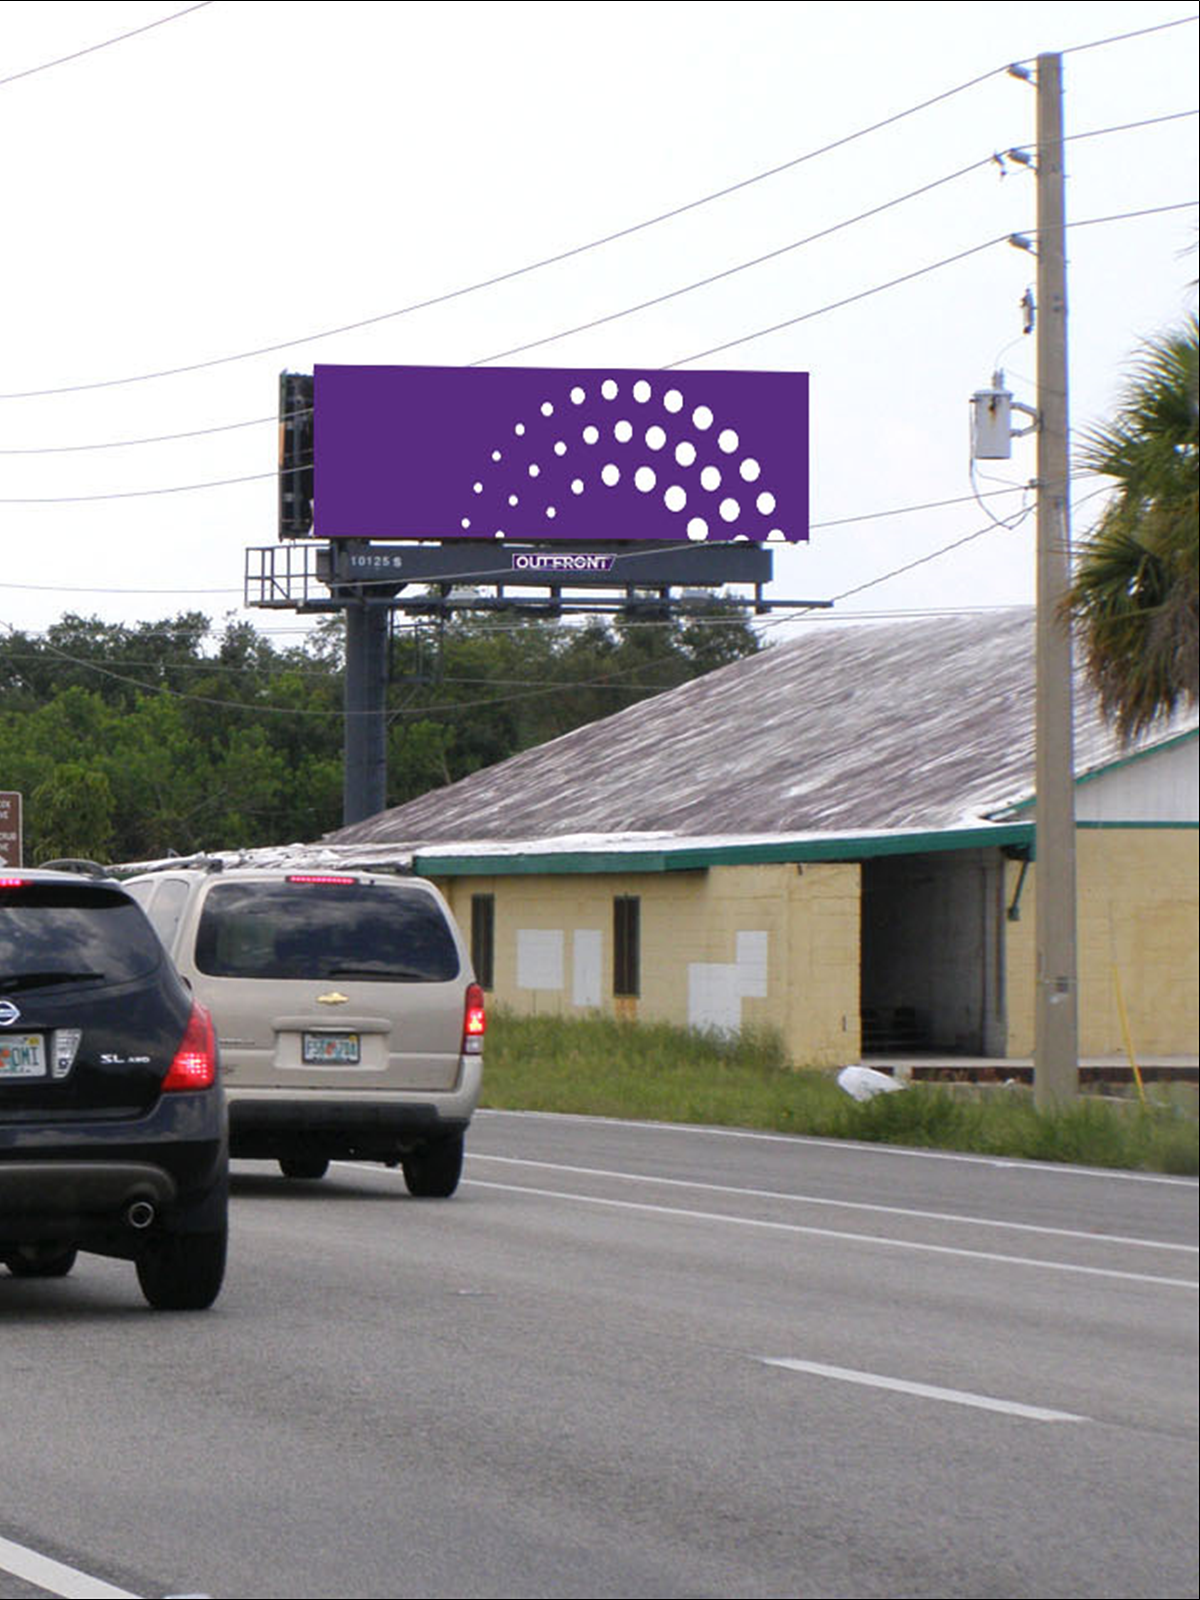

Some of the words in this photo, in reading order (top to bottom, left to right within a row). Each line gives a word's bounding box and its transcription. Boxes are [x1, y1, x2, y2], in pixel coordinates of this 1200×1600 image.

[351, 557, 389, 566] 10125
[514, 555, 610, 569] OUTFRONT
[100, 1053, 125, 1064] SL
